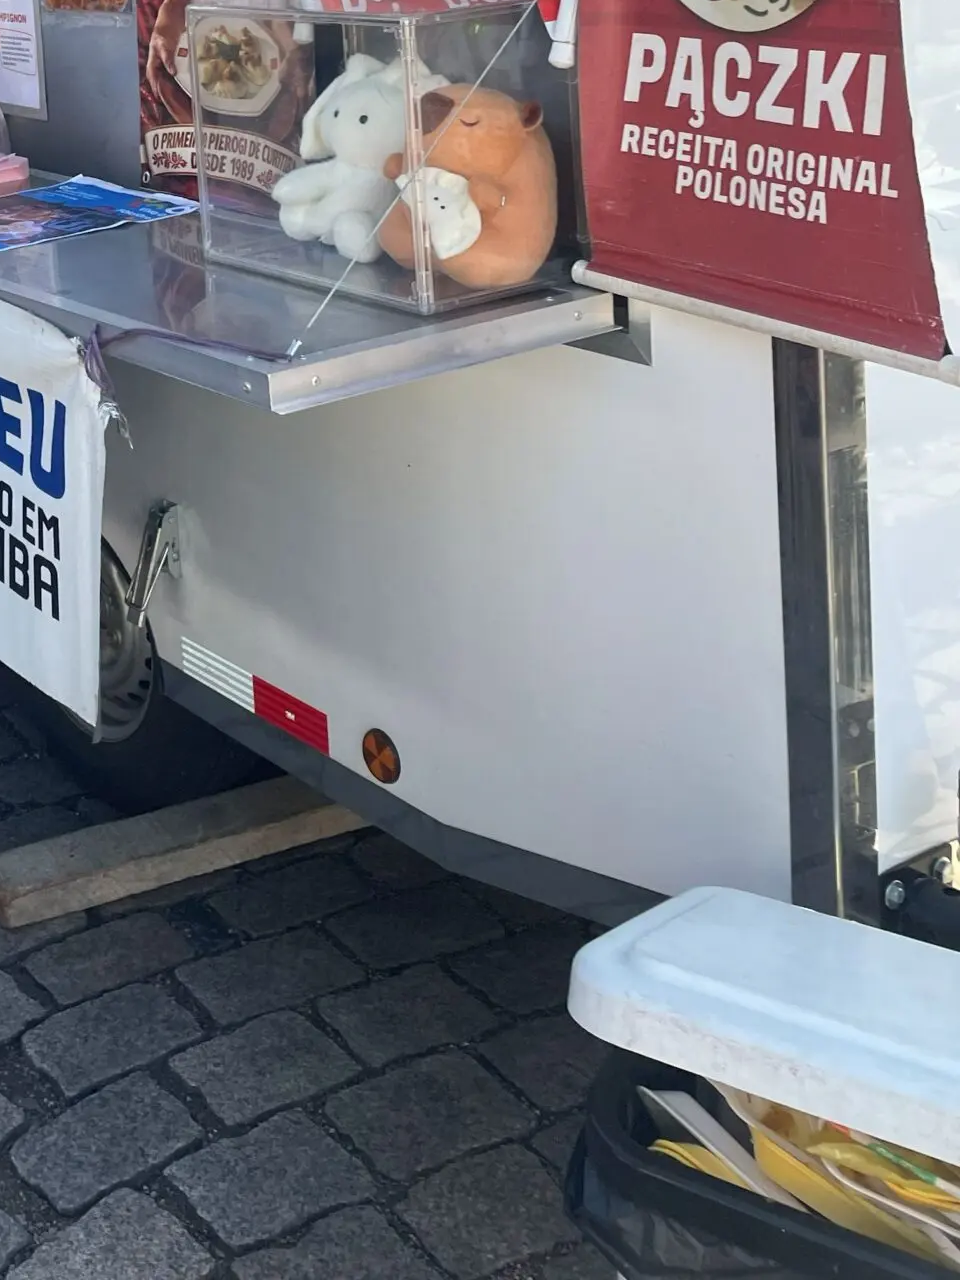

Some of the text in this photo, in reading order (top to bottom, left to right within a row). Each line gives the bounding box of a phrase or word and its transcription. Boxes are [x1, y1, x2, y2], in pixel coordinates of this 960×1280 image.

[153, 134, 159, 150] O
[208, 132, 247, 155] PIEROGI
[248, 140, 260, 159] DE
[191, 152, 255, 180] DSDE 1989
[620, 124, 899, 198] RECEITA ORIGINAL
[675, 165, 828, 224] POLONESA
[22, 495, 61, 561] EM
